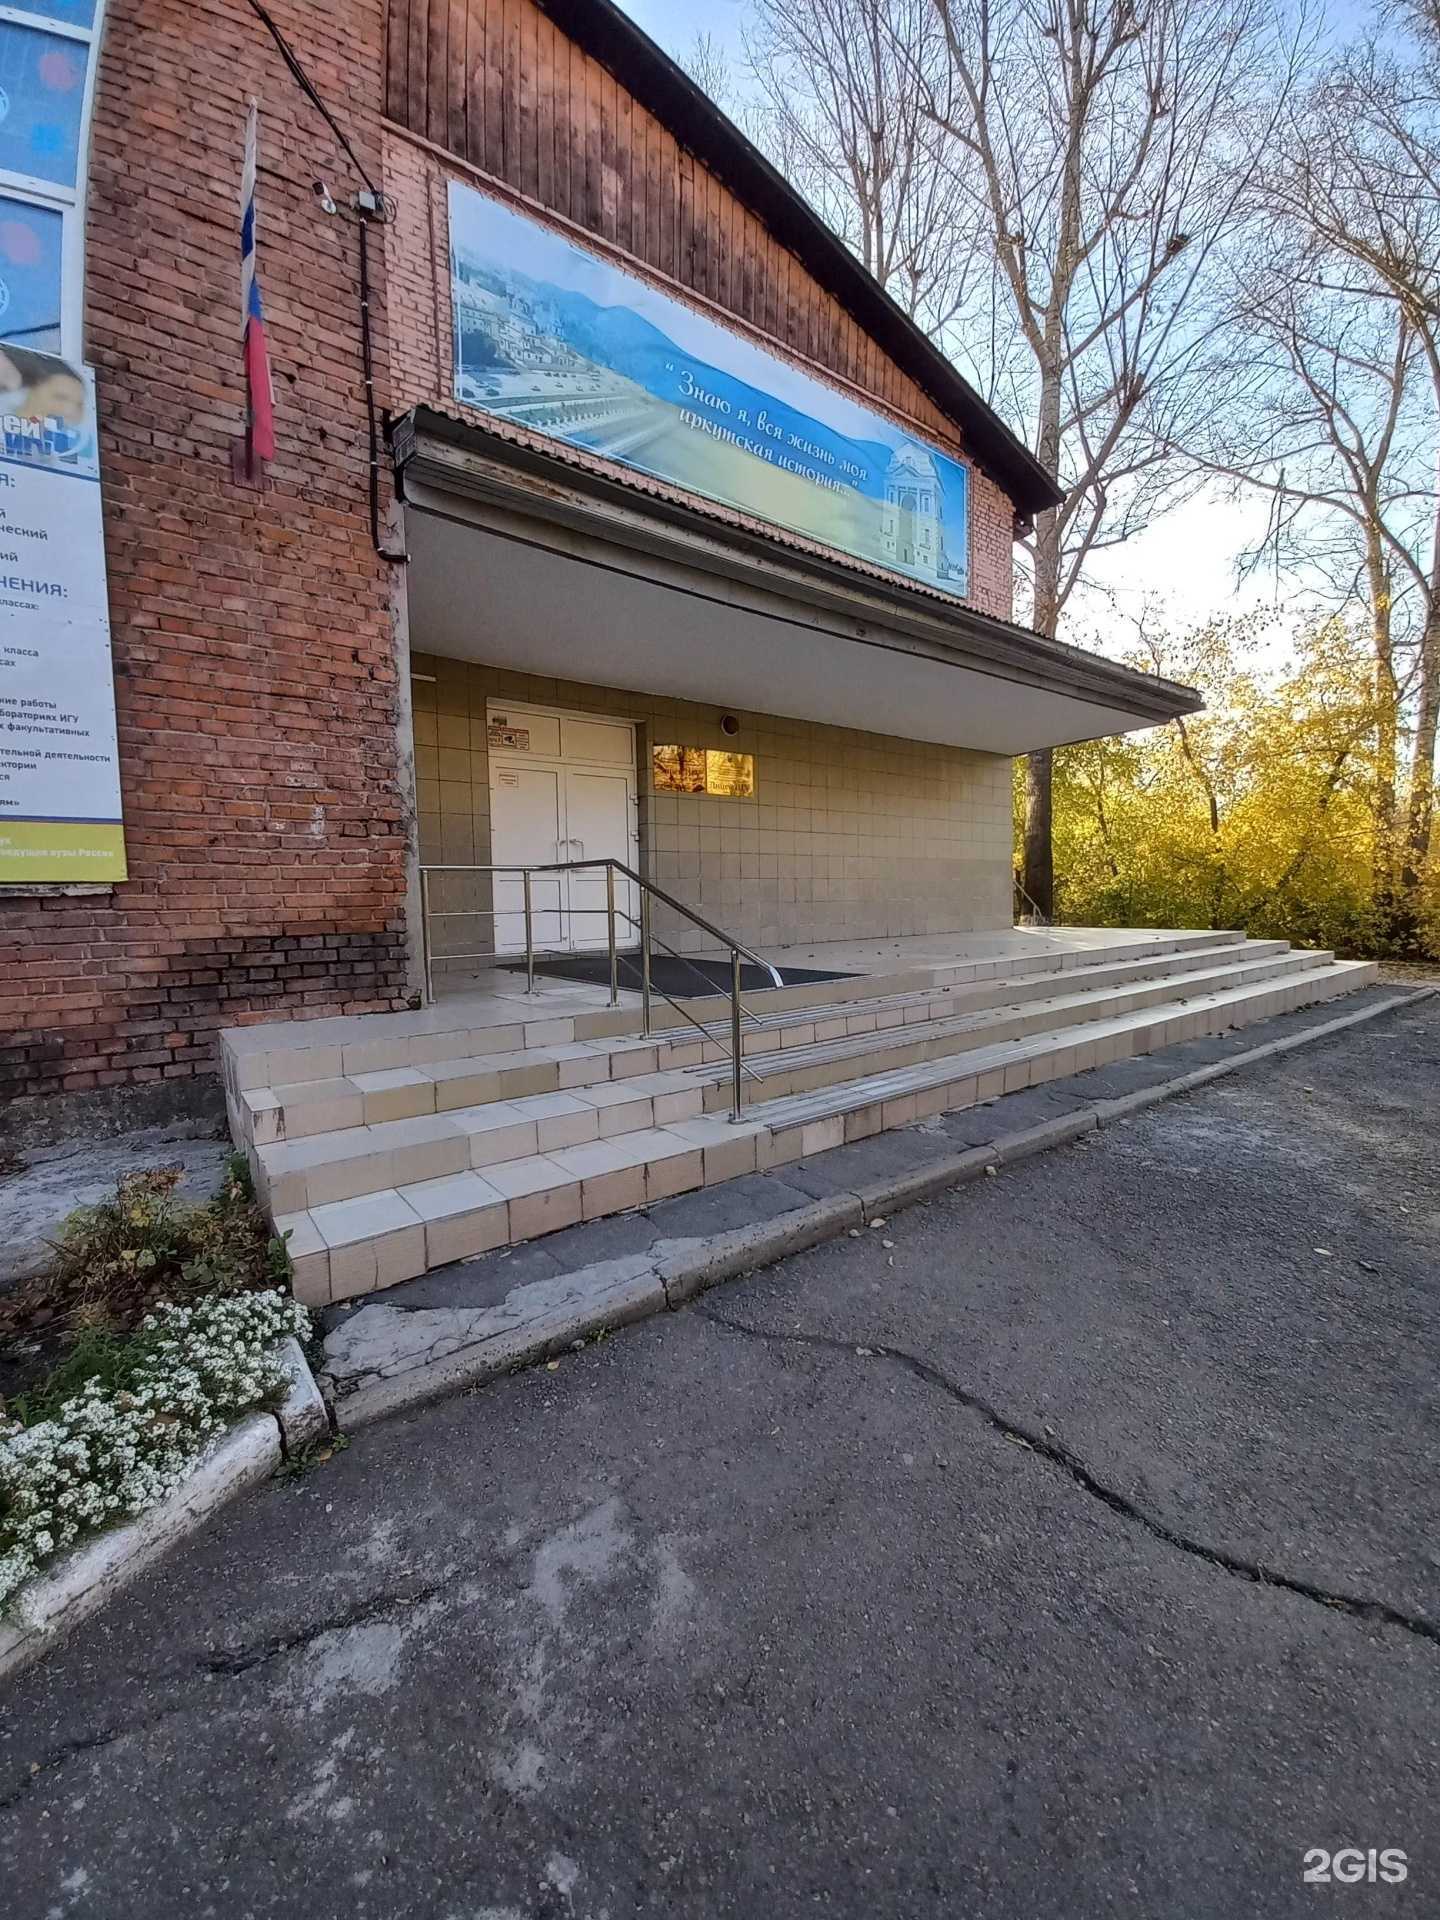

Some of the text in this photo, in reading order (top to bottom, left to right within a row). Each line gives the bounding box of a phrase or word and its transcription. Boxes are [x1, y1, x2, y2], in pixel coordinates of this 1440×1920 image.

[0, 413, 41, 440] ей
[680, 408, 773, 462] иркутская
[738, 409, 751, 427] я,
[757, 410, 783, 440] вся
[787, 433, 835, 465] жизнь
[839, 459, 868, 481] моя
[3, 647, 39, 657] класса
[20, 699, 57, 709] работы
[59, 713, 79, 723] ИГУ
[7, 722, 90, 737] факультативных
[44, 751, 110, 763] деятельности
